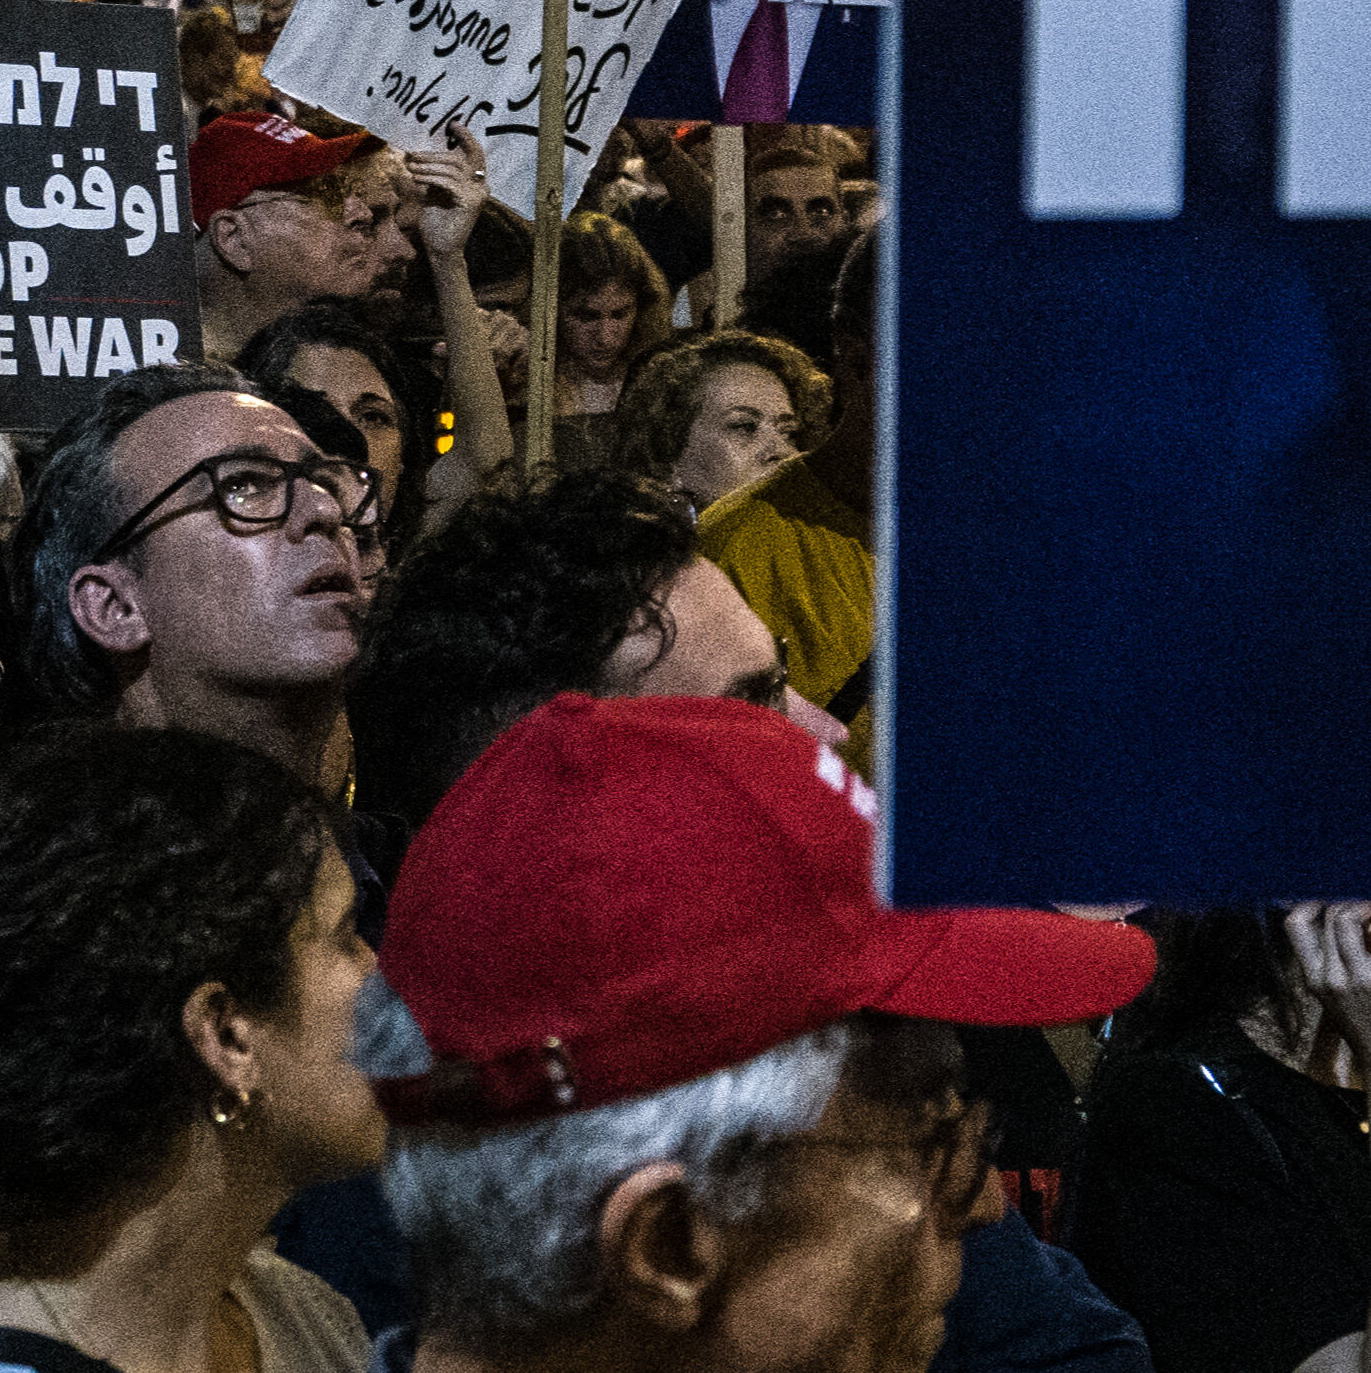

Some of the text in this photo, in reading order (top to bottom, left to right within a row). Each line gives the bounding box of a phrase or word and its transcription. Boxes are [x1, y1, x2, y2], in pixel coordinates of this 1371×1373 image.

[96, 68, 158, 132] די
[5, 144, 181, 257] أوقف
[28, 315, 180, 378] WAR
